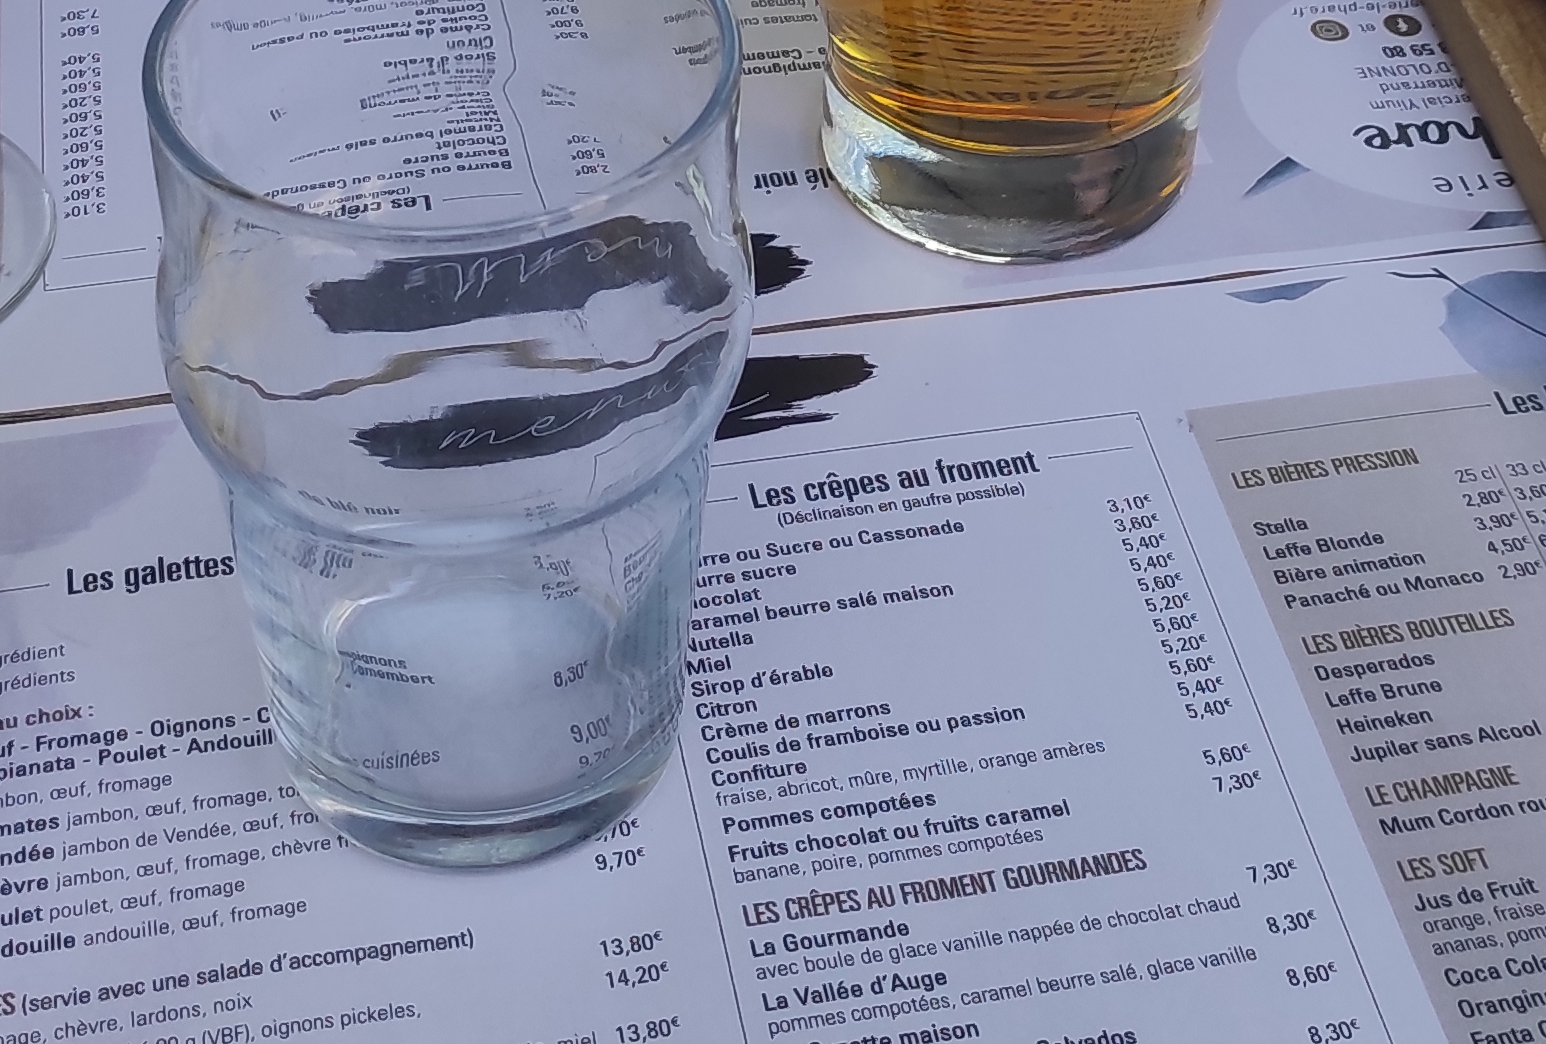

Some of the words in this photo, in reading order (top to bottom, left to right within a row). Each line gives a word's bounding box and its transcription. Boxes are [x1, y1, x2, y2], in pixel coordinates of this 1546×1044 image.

[63, 186, 106, 203] 3,60€
[63, 202, 106, 219] 3,10€
[1493, 387, 1543, 416] Les
[747, 482, 797, 509] Les
[803, 472, 891, 503] crêpes
[896, 468, 930, 490] au
[934, 450, 1041, 485] froment
[1230, 468, 1266, 490] LES
[1266, 459, 1330, 485] BIÈRES
[1330, 447, 1420, 476] PRESSION
[1454, 468, 1478, 484] 25
[1480, 464, 1500, 480] cl
[777, 504, 875, 529] (Déclinaison
[877, 500, 898, 512] en
[901, 492, 953, 512] gaufre
[955, 481, 1025, 506] possible)
[1252, 517, 1309, 537] Stella
[1262, 541, 1312, 561] Leffe
[1315, 531, 1385, 553] Blonde
[66, 568, 114, 596] Les
[124, 554, 238, 594] galettes
[1272, 567, 1328, 585] Bière
[1331, 552, 1426, 577] animation
[1301, 633, 1338, 655] LES
[1338, 623, 1405, 651] BIÈRES
[1405, 608, 1515, 641] BOUTEILLES
[690, 679, 745, 698] Sirop
[750, 662, 834, 689] d'érable
[1313, 652, 1436, 682] Desperados
[695, 699, 758, 720] Citron
[700, 721, 769, 742] Crème
[774, 714, 800, 731] de
[805, 703, 891, 727] marrons
[1336, 710, 1434, 735] Heineken
[705, 741, 771, 765] Coulis
[775, 736, 802, 754] de
[805, 723, 910, 750] framboise
[915, 718, 942, 734] ou
[946, 707, 1026, 734] passion
[1201, 743, 1251, 767] 5,60€
[711, 761, 808, 787] Confiture
[715, 786, 773, 807] fraise,
[776, 776, 844, 798] abricot,
[848, 770, 898, 788] mûre,
[902, 757, 974, 782] myrtille,
[978, 750, 1038, 770] orange
[1042, 741, 1106, 761] amères
[1211, 770, 1262, 794] 7,30€
[1364, 784, 1394, 808] LE
[1391, 764, 1520, 803] CHAMPAGNE
[721, 809, 814, 835] Pommes
[820, 792, 937, 821] compotées
[1378, 815, 1436, 836] Mum
[1437, 802, 1515, 826] Cordon
[1245, 858, 1297, 885] 7,30€
[1396, 856, 1436, 882] LES
[1436, 847, 1490, 876] SOFT
[741, 900, 781, 927] LES
[784, 889, 862, 921] CRÊPES
[867, 884, 896, 910] AU
[898, 869, 997, 906] FROMENT
[1002, 848, 1148, 890] GOURMANDES
[749, 939, 777, 959] La
[782, 919, 910, 953] Gourmande
[21, 986, 91, 1017] (servie
[97, 981, 146, 1002] avec
[152, 973, 190, 993] une
[196, 960, 264, 985] salade
[269, 929, 474, 973] d'accompagnement)
